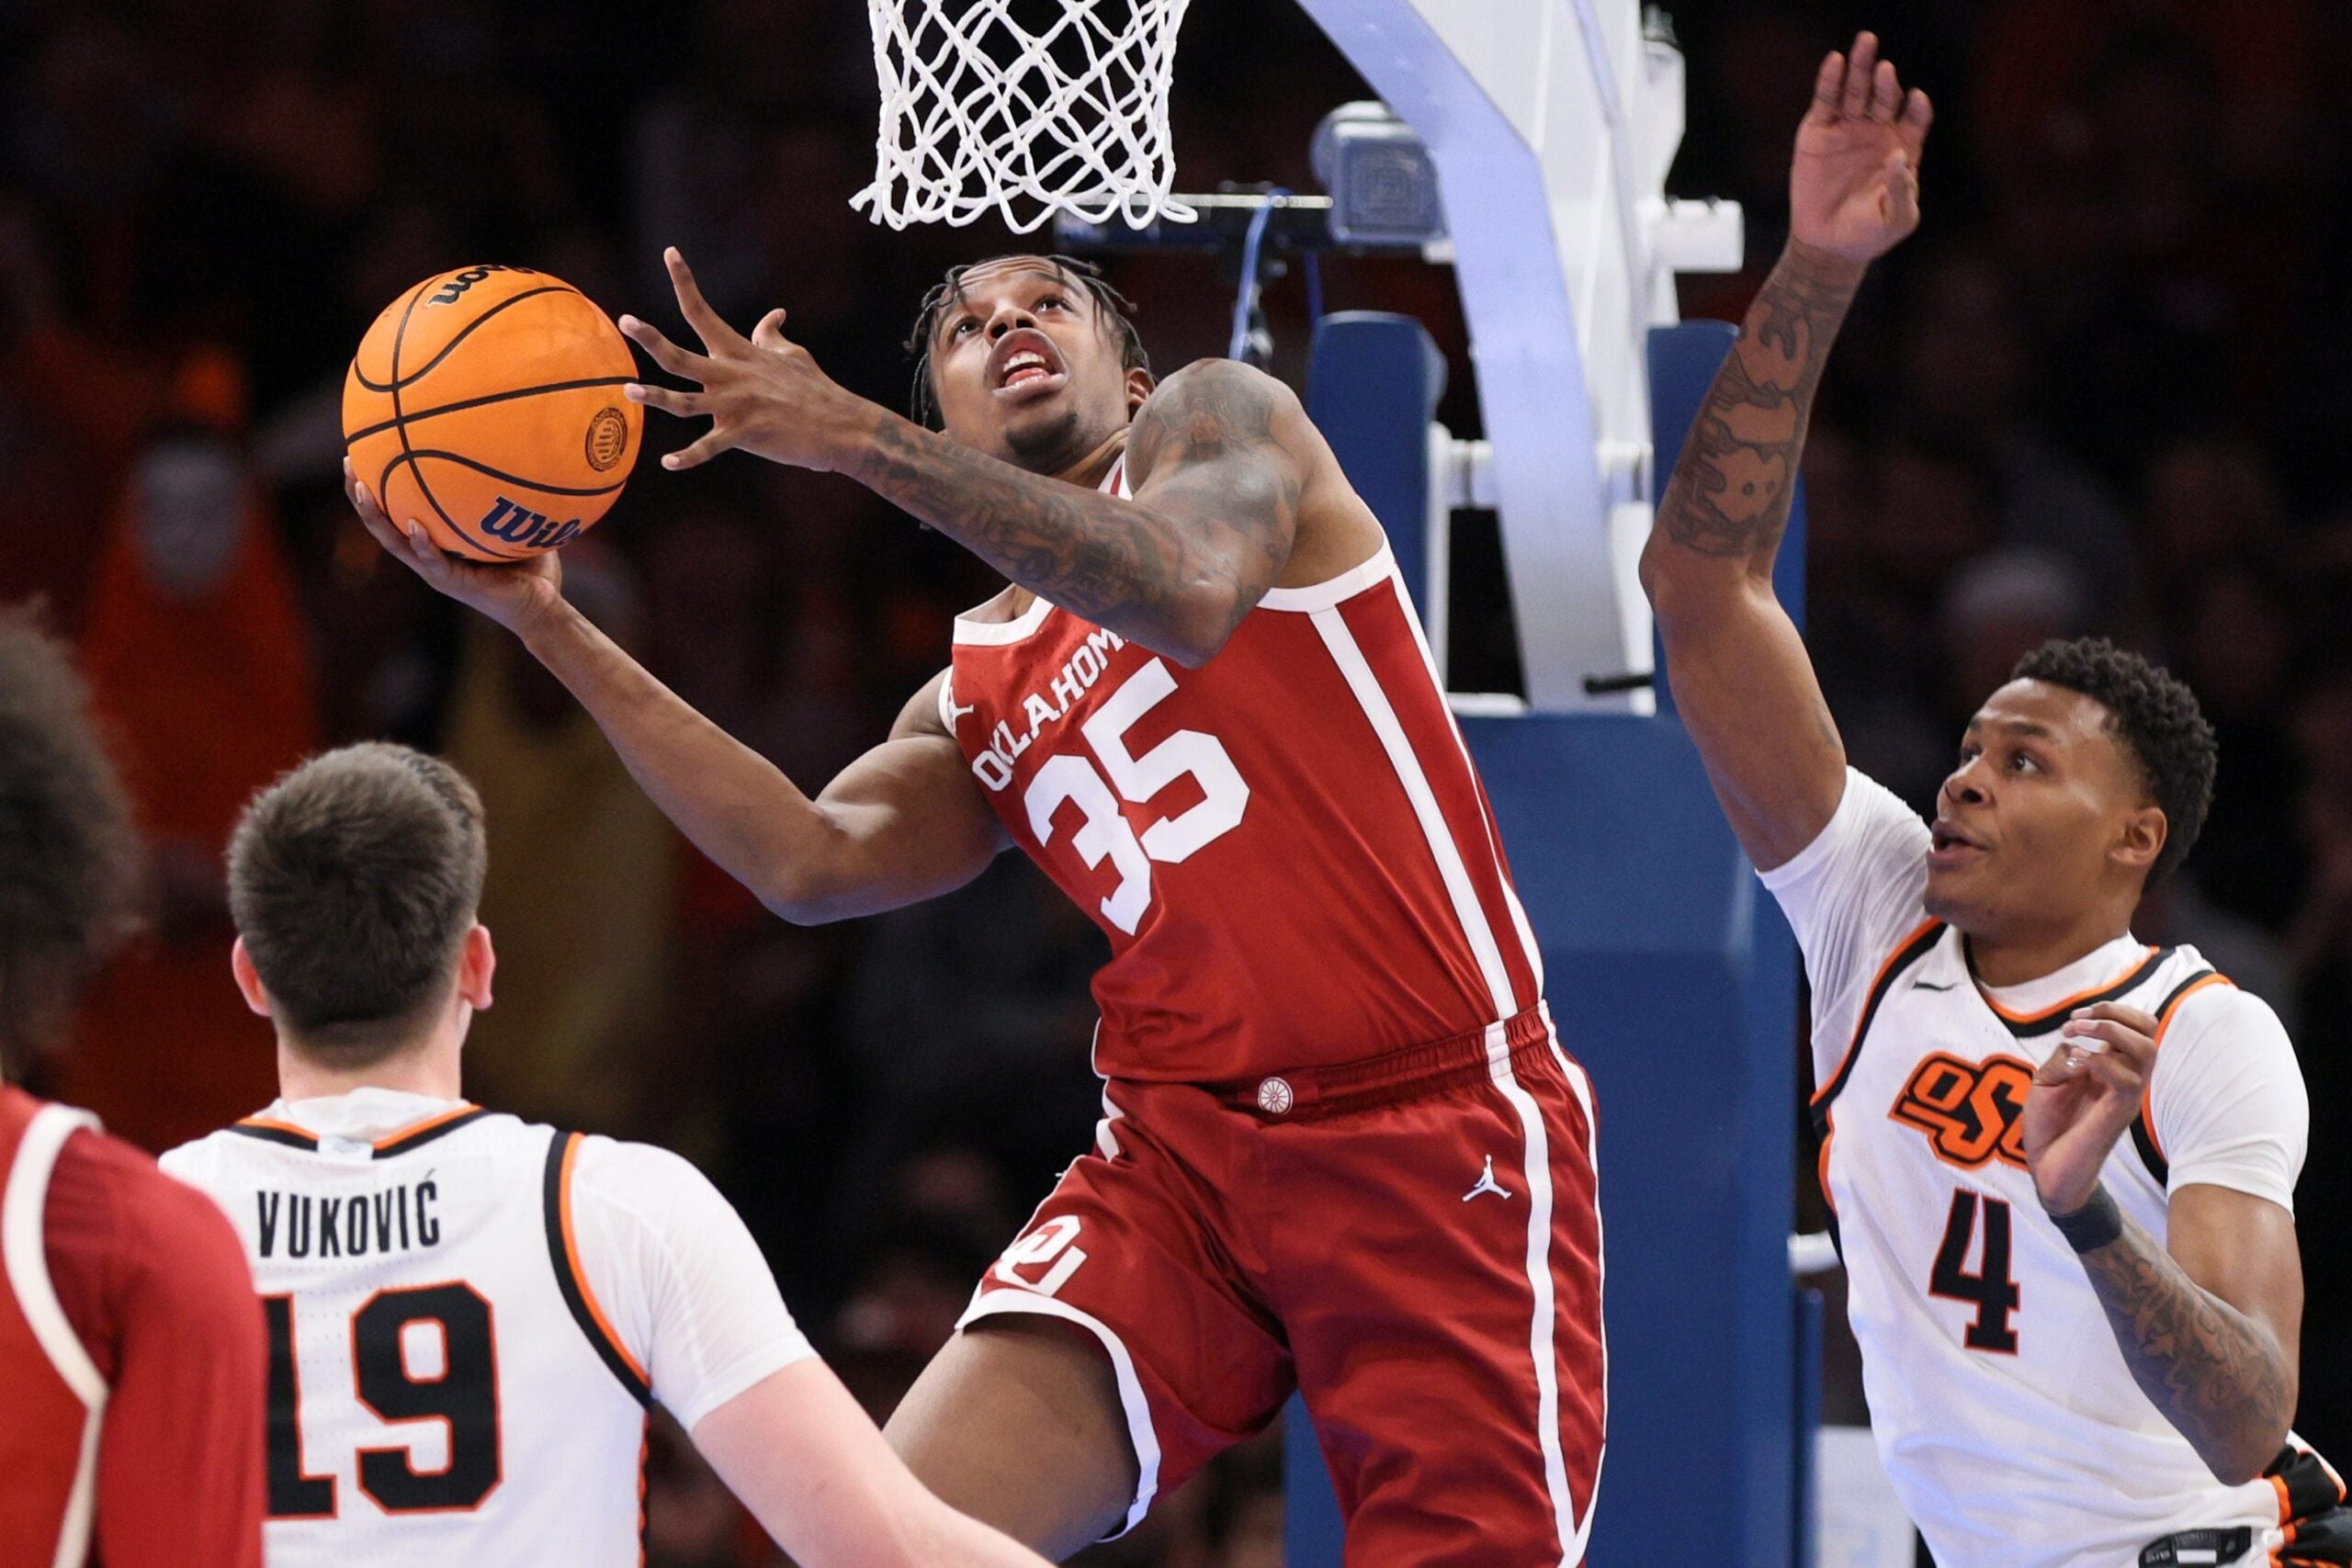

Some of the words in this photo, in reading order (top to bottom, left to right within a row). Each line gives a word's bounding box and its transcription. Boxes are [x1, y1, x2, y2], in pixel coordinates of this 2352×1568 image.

[972, 627, 1129, 792] OKLAHOM
[1023, 656, 1250, 936] 35
[257, 1168, 440, 1258] VUKOVIĆ
[1928, 1187, 2020, 1355] 4
[261, 1280, 503, 1520] 19
